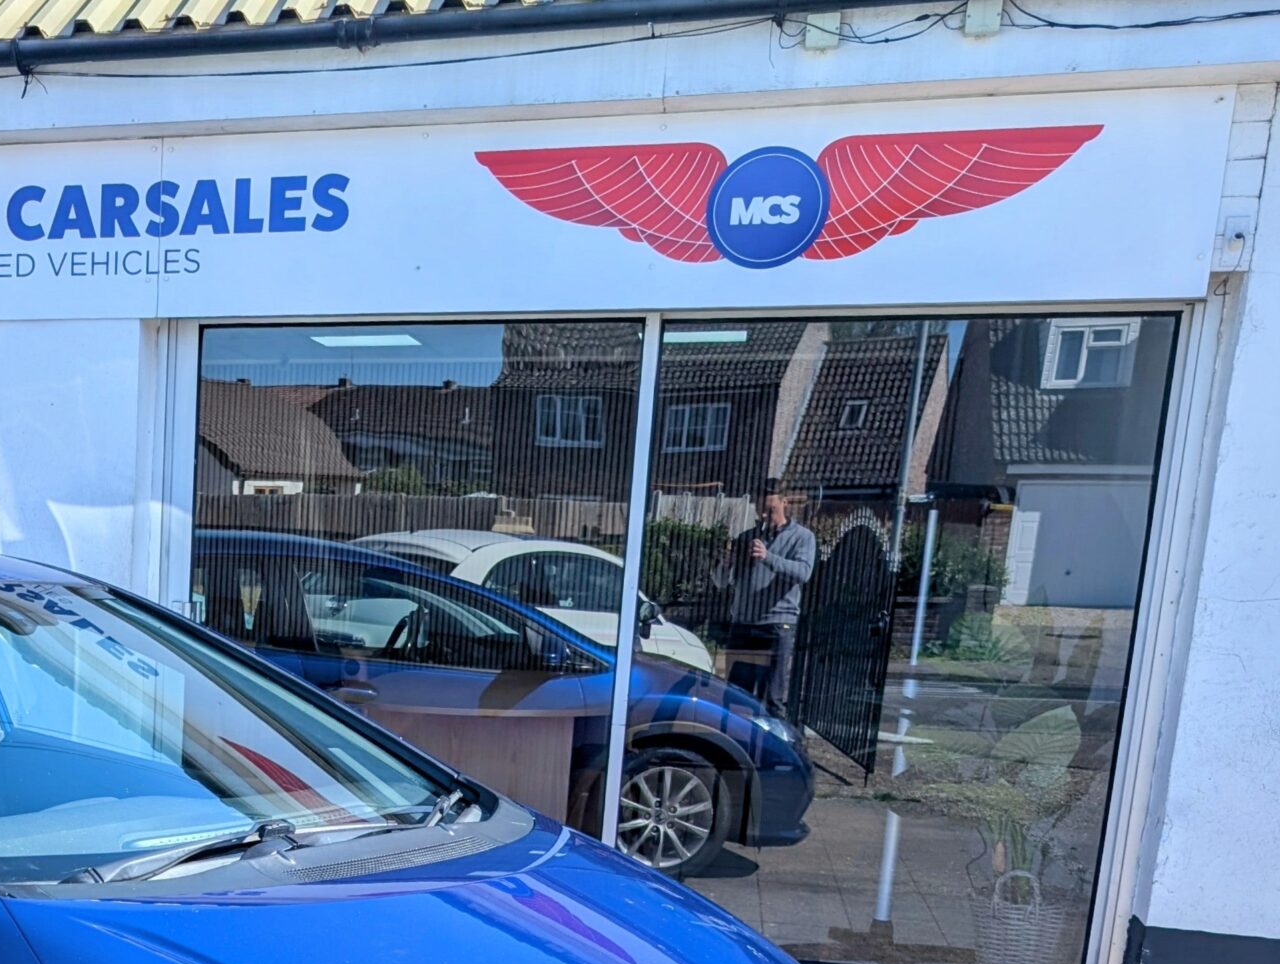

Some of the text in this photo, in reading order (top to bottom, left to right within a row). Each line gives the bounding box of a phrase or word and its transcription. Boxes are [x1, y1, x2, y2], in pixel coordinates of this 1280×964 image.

[6, 173, 351, 241] CARSALES
[729, 194, 802, 226] MCS
[47, 248, 201, 277] VEHICLES
